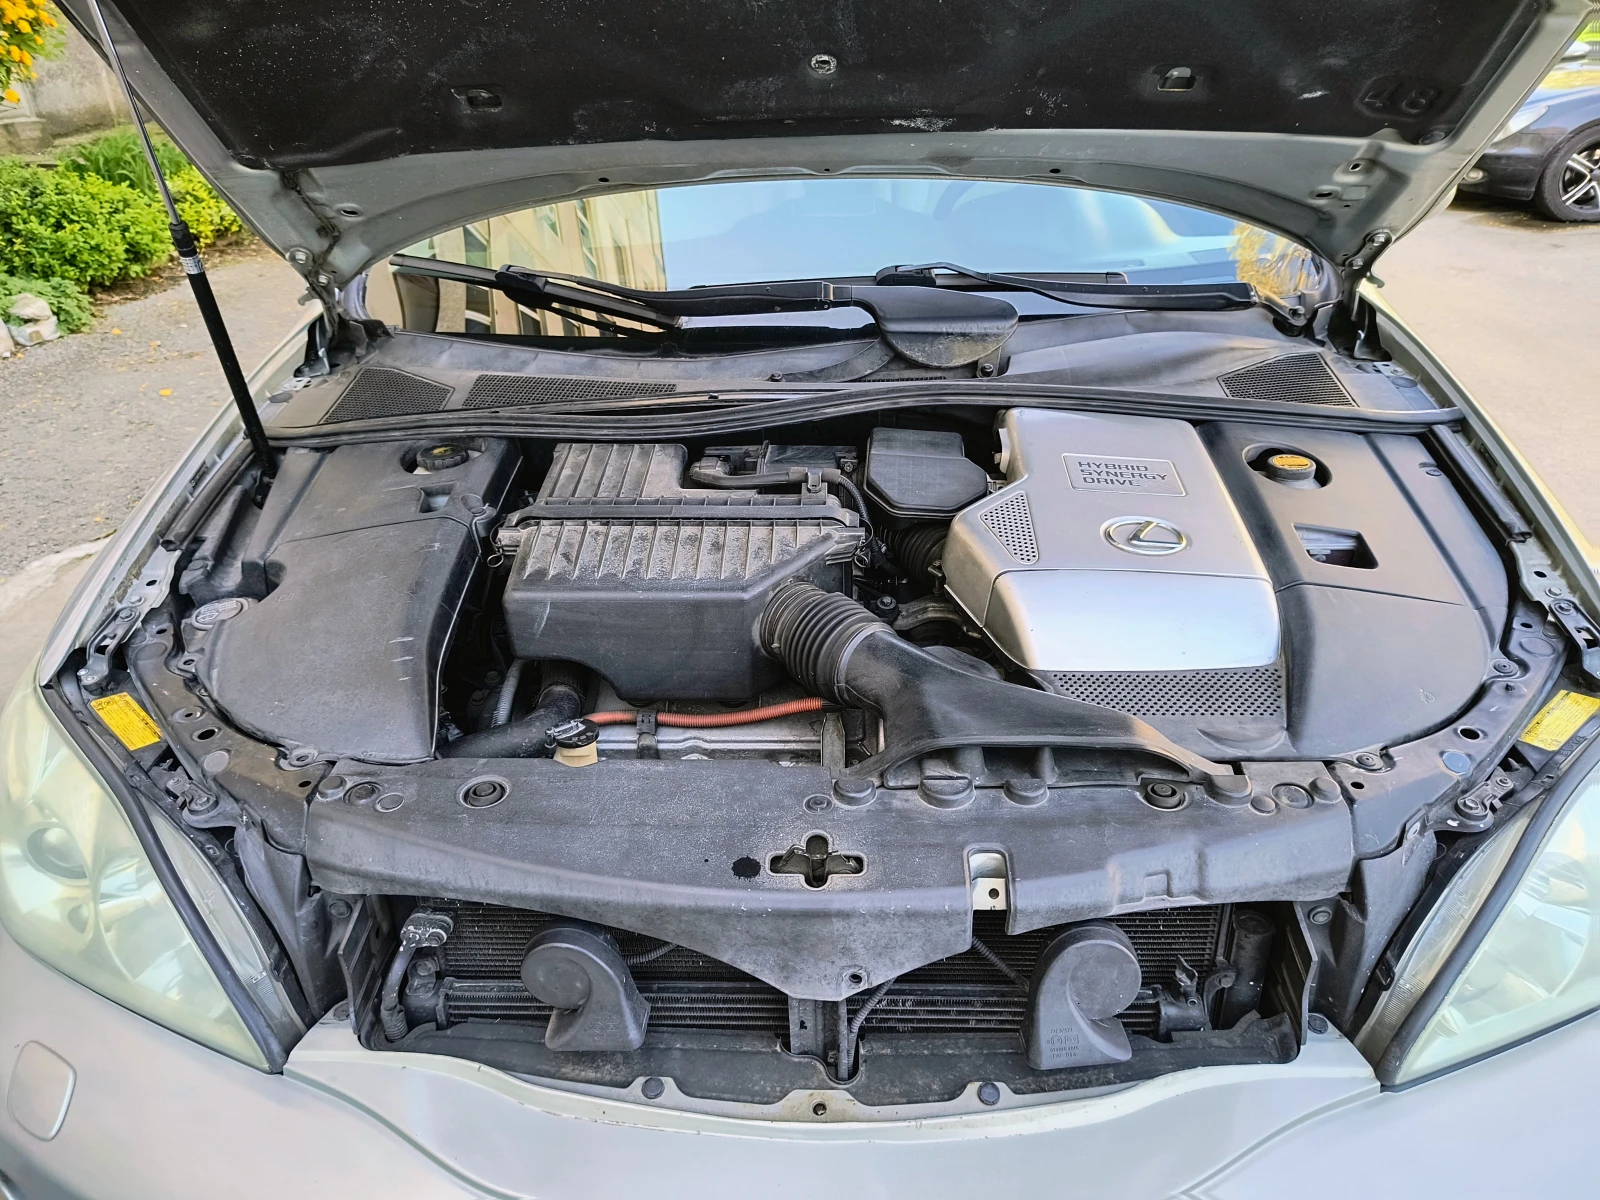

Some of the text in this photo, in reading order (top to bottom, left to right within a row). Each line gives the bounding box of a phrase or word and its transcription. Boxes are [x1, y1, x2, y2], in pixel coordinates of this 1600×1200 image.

[1078, 461, 1148, 472] HYBRID
[1080, 469, 1167, 481] SYNERGY
[1082, 477, 1141, 487] DRIVE
